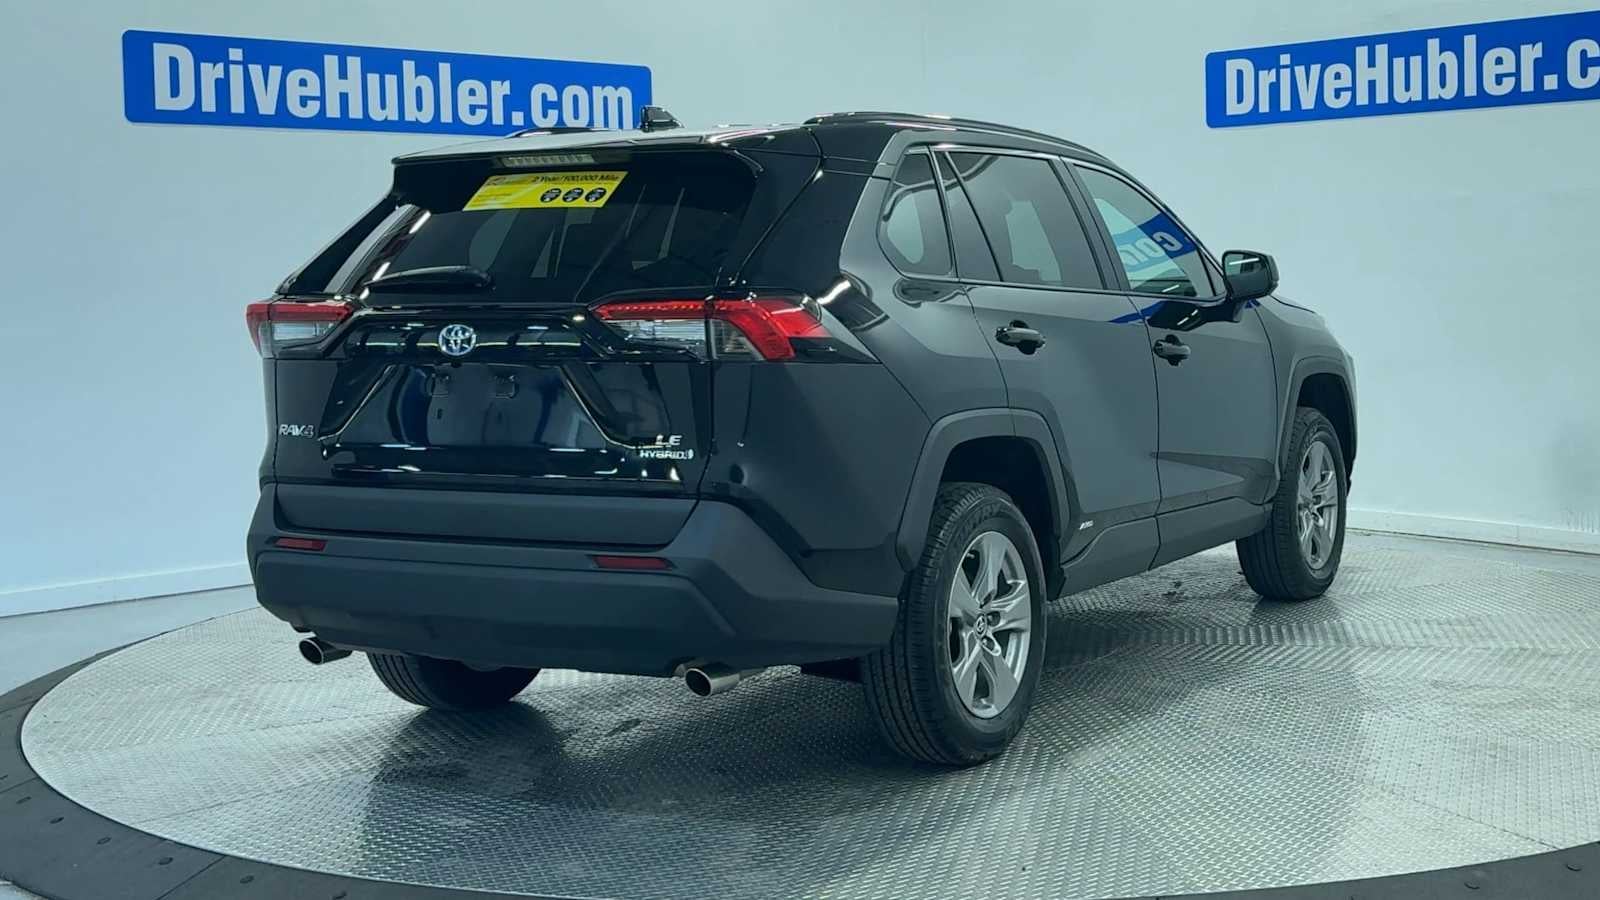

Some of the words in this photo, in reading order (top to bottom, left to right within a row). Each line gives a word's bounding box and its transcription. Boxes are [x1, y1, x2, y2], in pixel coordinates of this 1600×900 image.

[153, 43, 633, 129] DriveHubler.com
[280, 424, 314, 438] RAV4
[655, 434, 682, 445] LE
[640, 449, 685, 459] HYBRID
